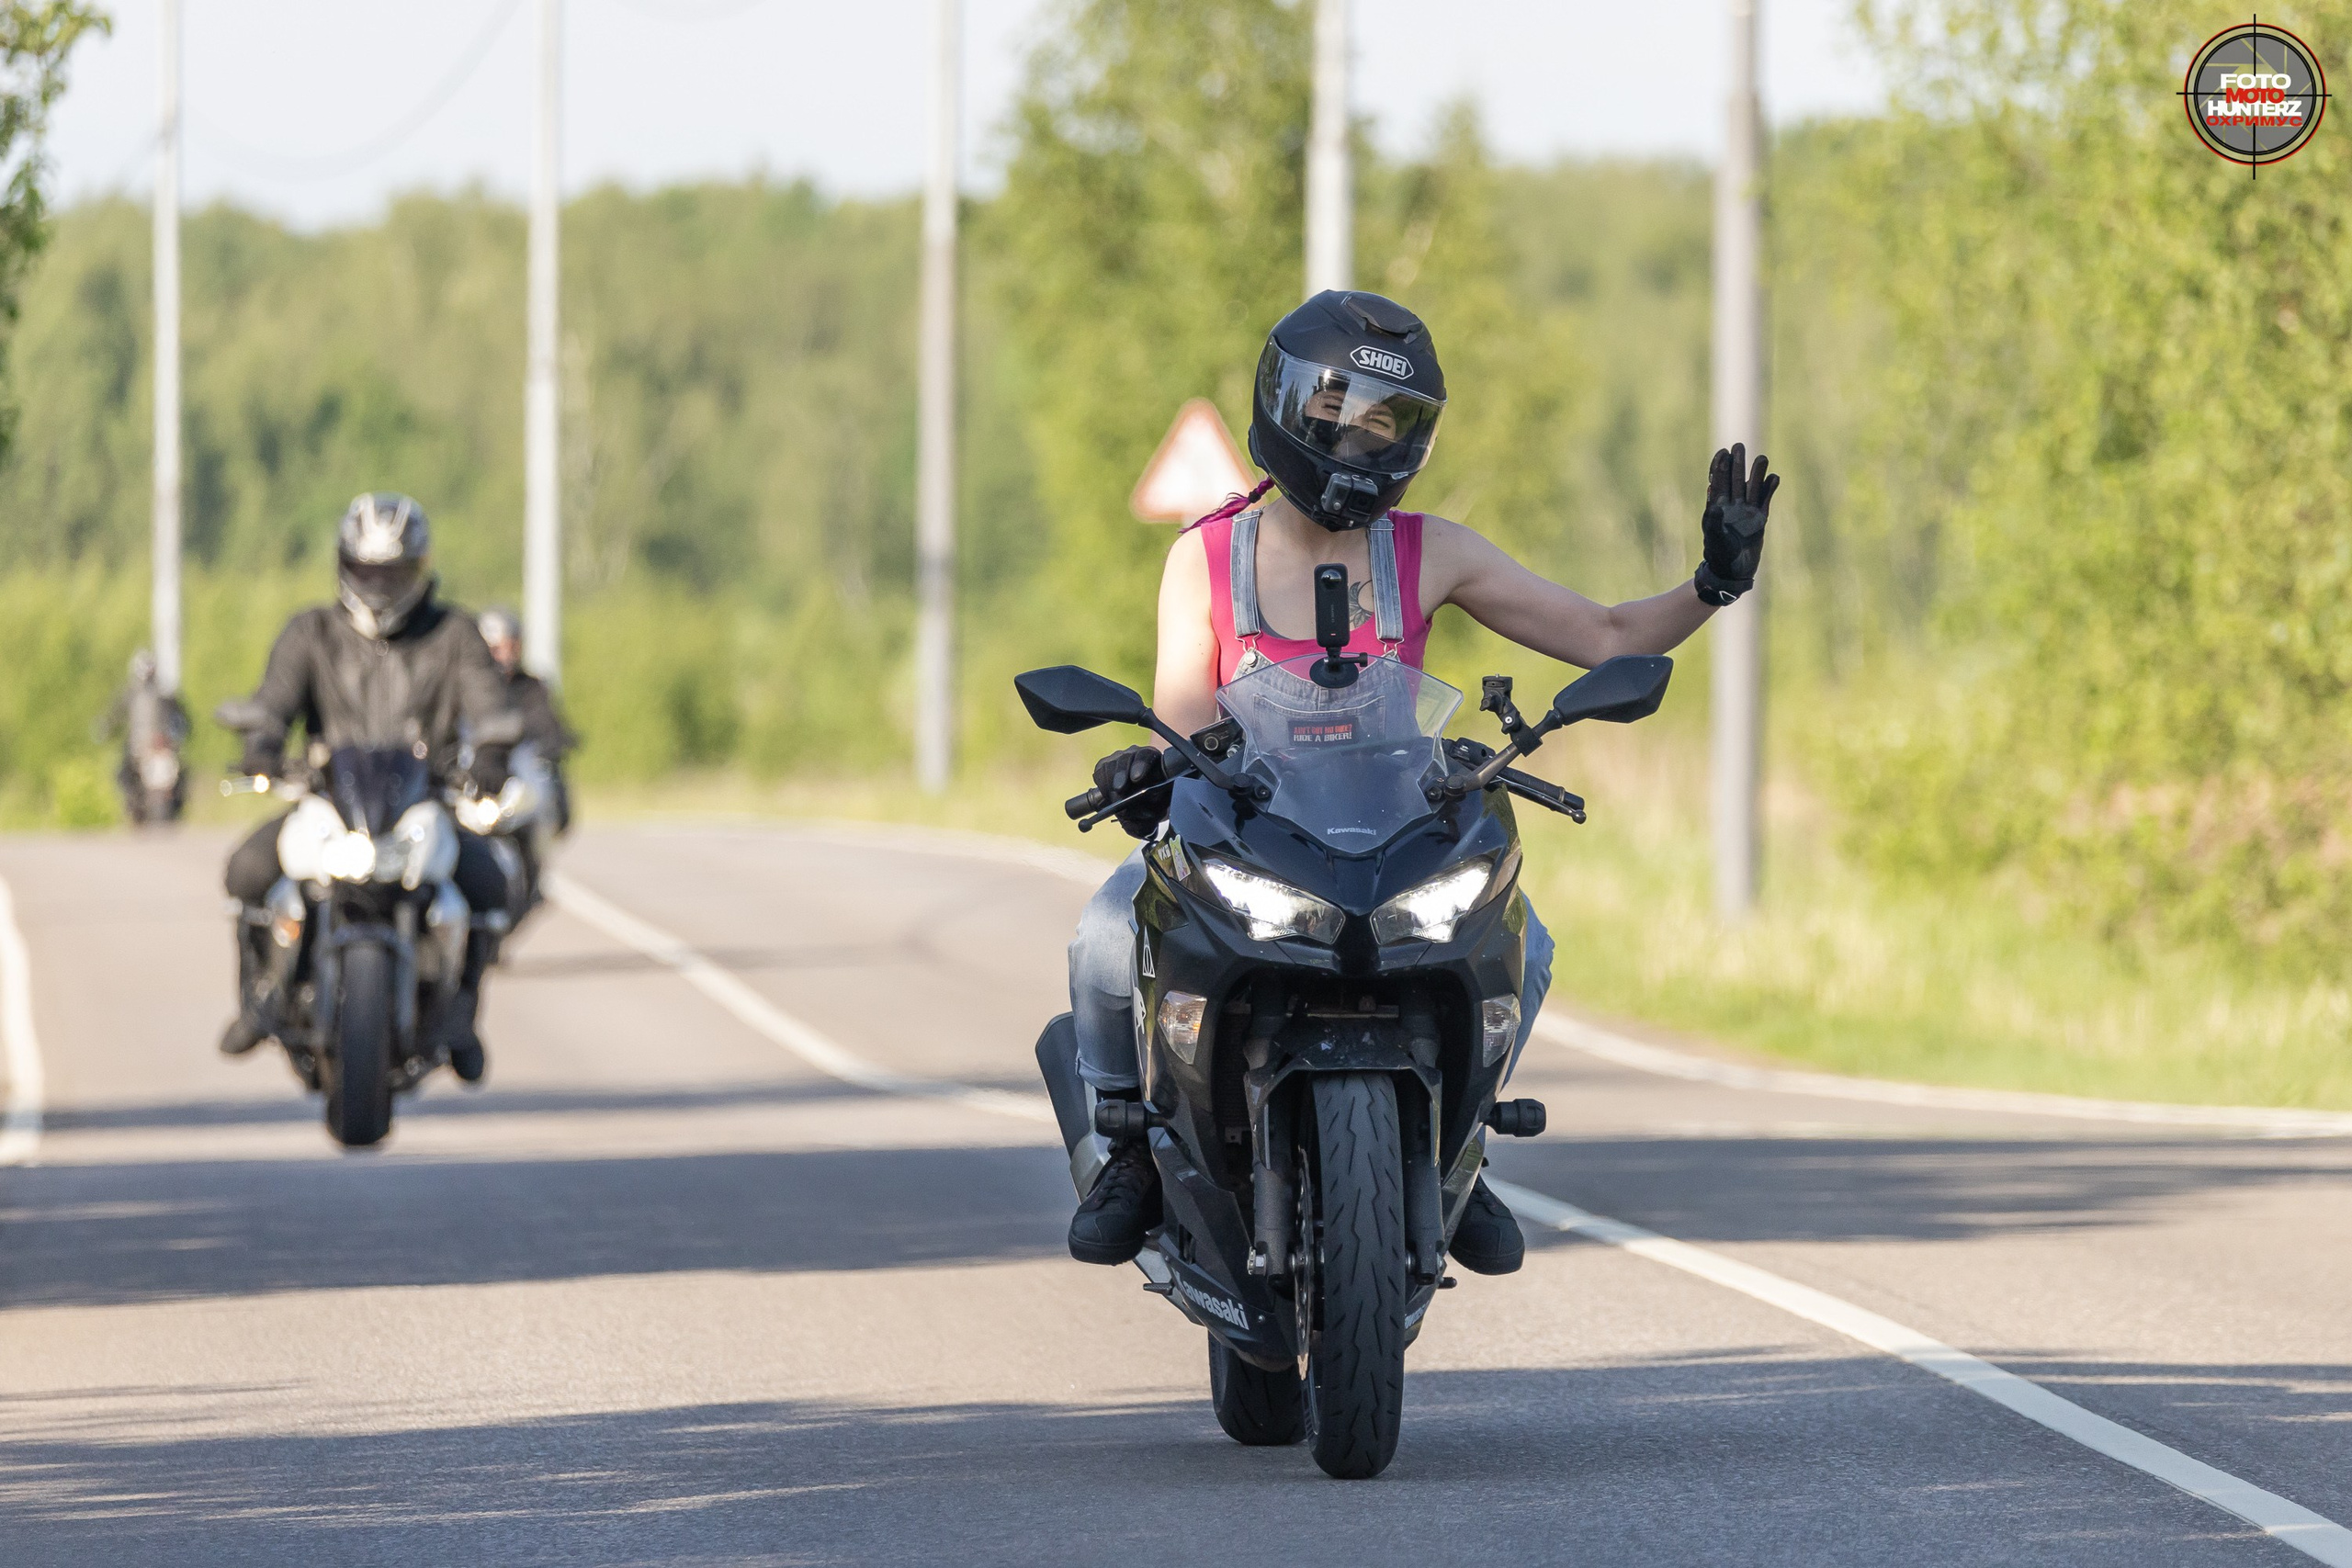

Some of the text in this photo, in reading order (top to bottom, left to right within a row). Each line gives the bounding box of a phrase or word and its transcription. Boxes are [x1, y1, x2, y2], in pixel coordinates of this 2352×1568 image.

[1359, 349, 1408, 377] SHOEI
[1294, 731, 1352, 742] RIDE A BIKER!
[1327, 827, 1377, 836] Kawasaki
